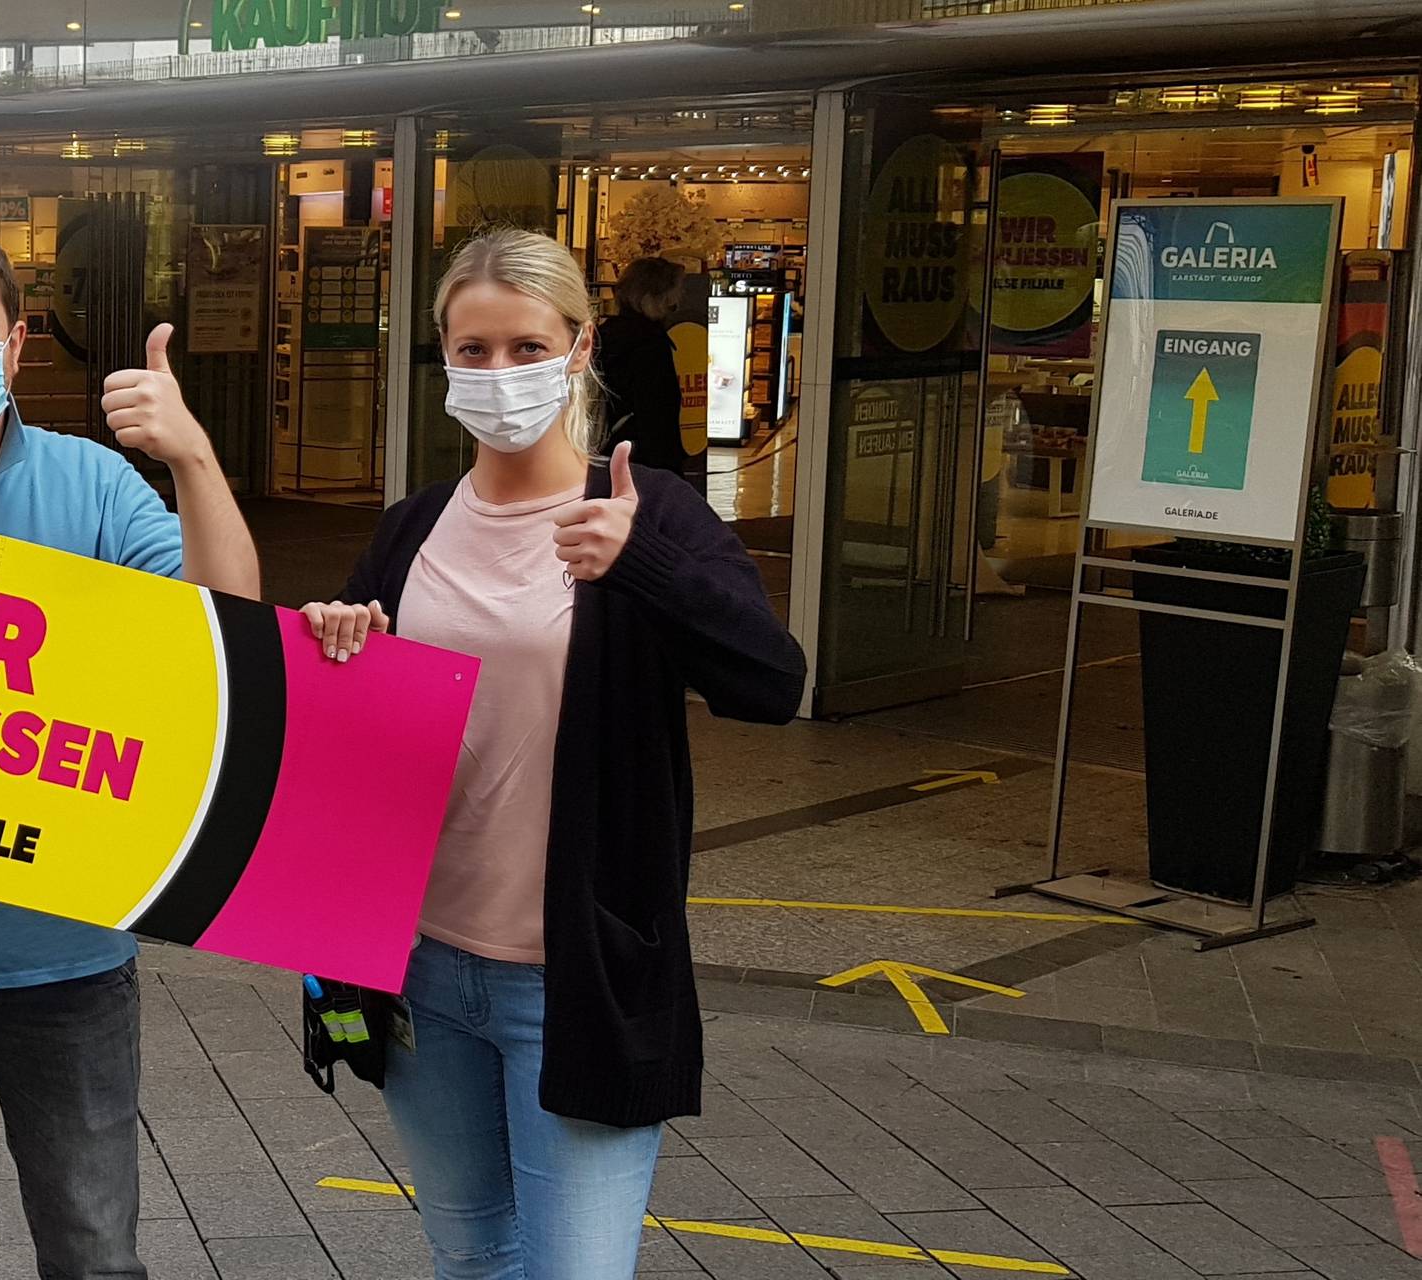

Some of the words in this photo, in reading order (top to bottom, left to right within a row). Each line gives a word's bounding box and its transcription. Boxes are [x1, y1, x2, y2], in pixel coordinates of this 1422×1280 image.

[885, 221, 957, 258] MUSS
[999, 216, 1057, 243] WIR
[994, 247, 1089, 267] LIESSEN
[1161, 247, 1277, 269] GALERIA
[881, 265, 956, 303] RAUS
[1021, 278, 1065, 290] FILIALE
[1172, 274, 1215, 282] KARSTADT
[1221, 275, 1262, 283] KAUFHOF
[1164, 338, 1251, 357] EINGANG
[1336, 383, 1379, 410] ALLE
[1176, 470, 1209, 479] GALERIA
[1164, 506, 1219, 520] GALERIA.DE
